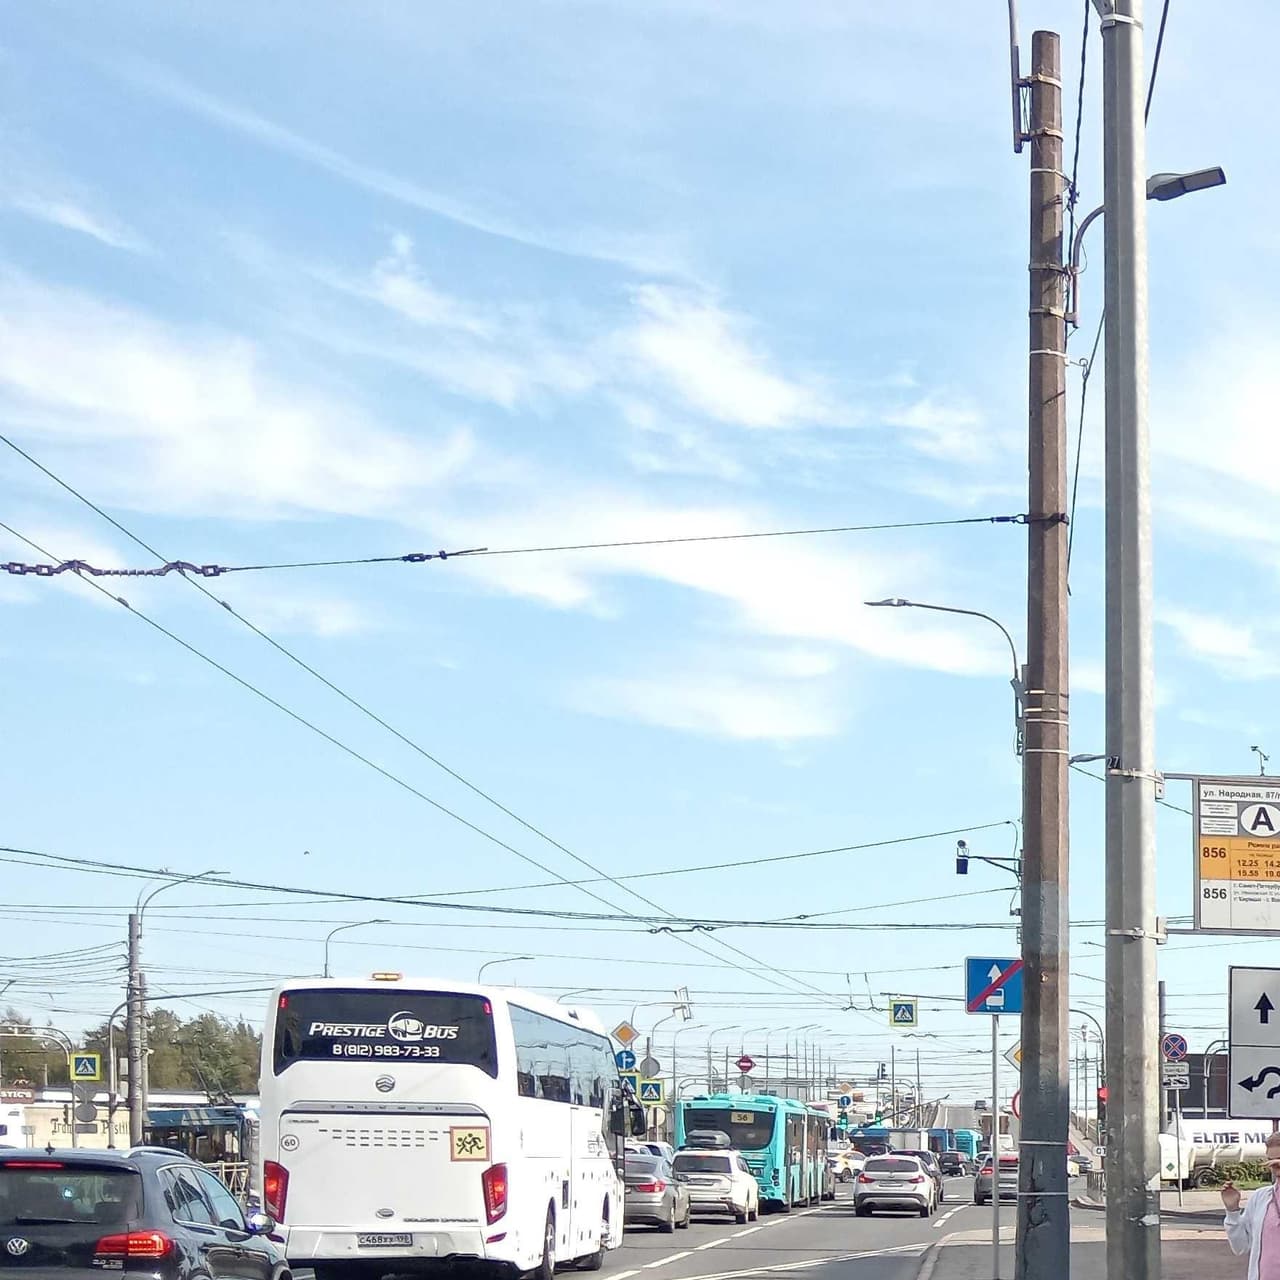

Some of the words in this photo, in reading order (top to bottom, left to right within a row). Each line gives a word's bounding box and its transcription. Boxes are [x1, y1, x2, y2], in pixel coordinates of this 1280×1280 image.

[1250, 806, 1275, 832] А
[1202, 846, 1227, 859] 856
[1203, 887, 1227, 899] 856
[308, 1022, 389, 1038] PRESTIGE
[333, 1044, 342, 1055] 8
[344, 1044, 373, 1056] (812)
[374, 1045, 440, 1057] 983-73-33
